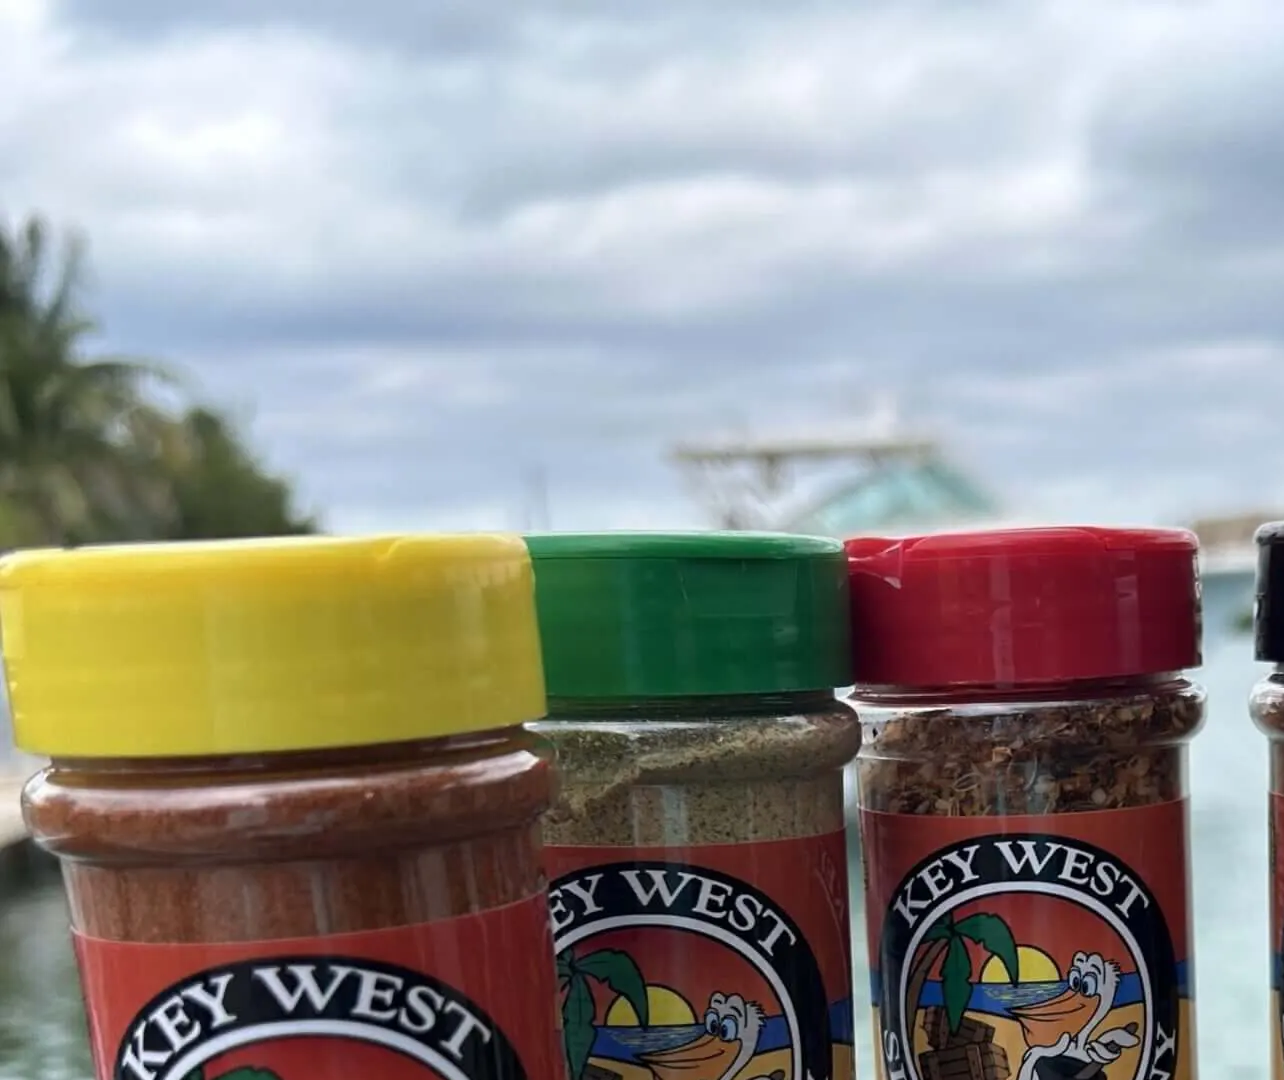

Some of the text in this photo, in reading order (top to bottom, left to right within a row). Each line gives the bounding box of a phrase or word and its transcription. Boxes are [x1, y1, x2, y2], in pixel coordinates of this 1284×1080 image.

[548, 869, 796, 958] EY WEST
[893, 841, 1149, 929] KEY WEST
[252, 964, 493, 1061] WEST
